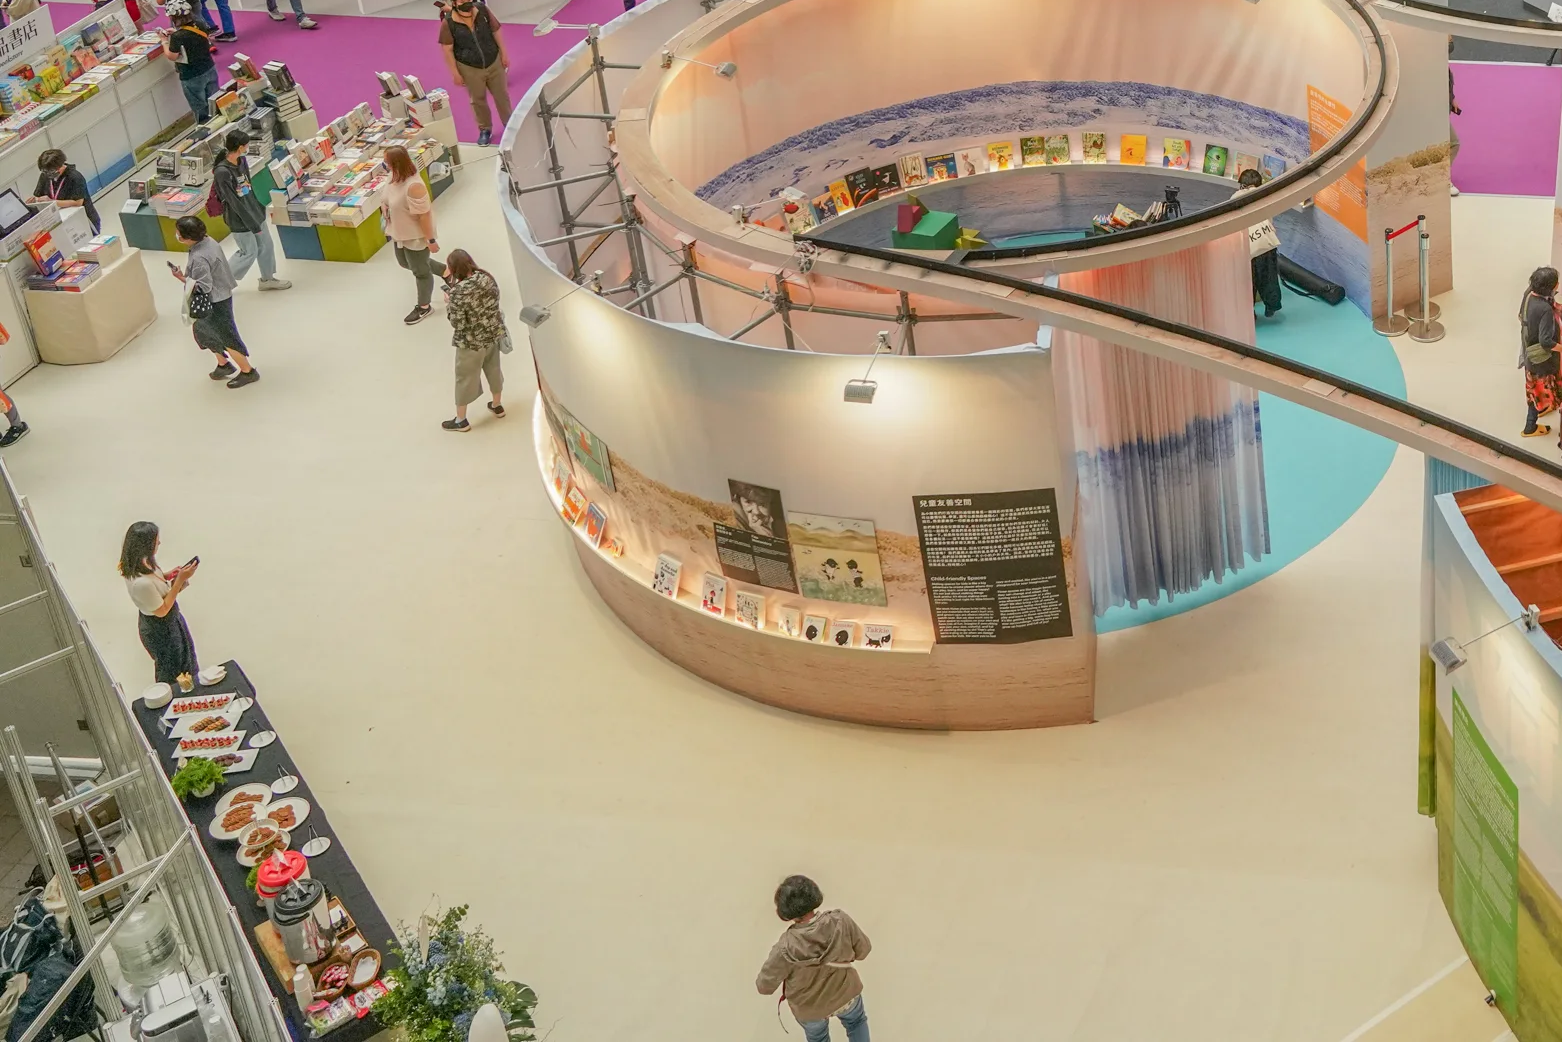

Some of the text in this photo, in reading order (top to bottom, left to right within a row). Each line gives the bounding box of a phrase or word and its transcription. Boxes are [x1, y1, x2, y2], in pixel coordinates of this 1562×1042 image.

[919, 498, 972, 508] 兒童友善空間
